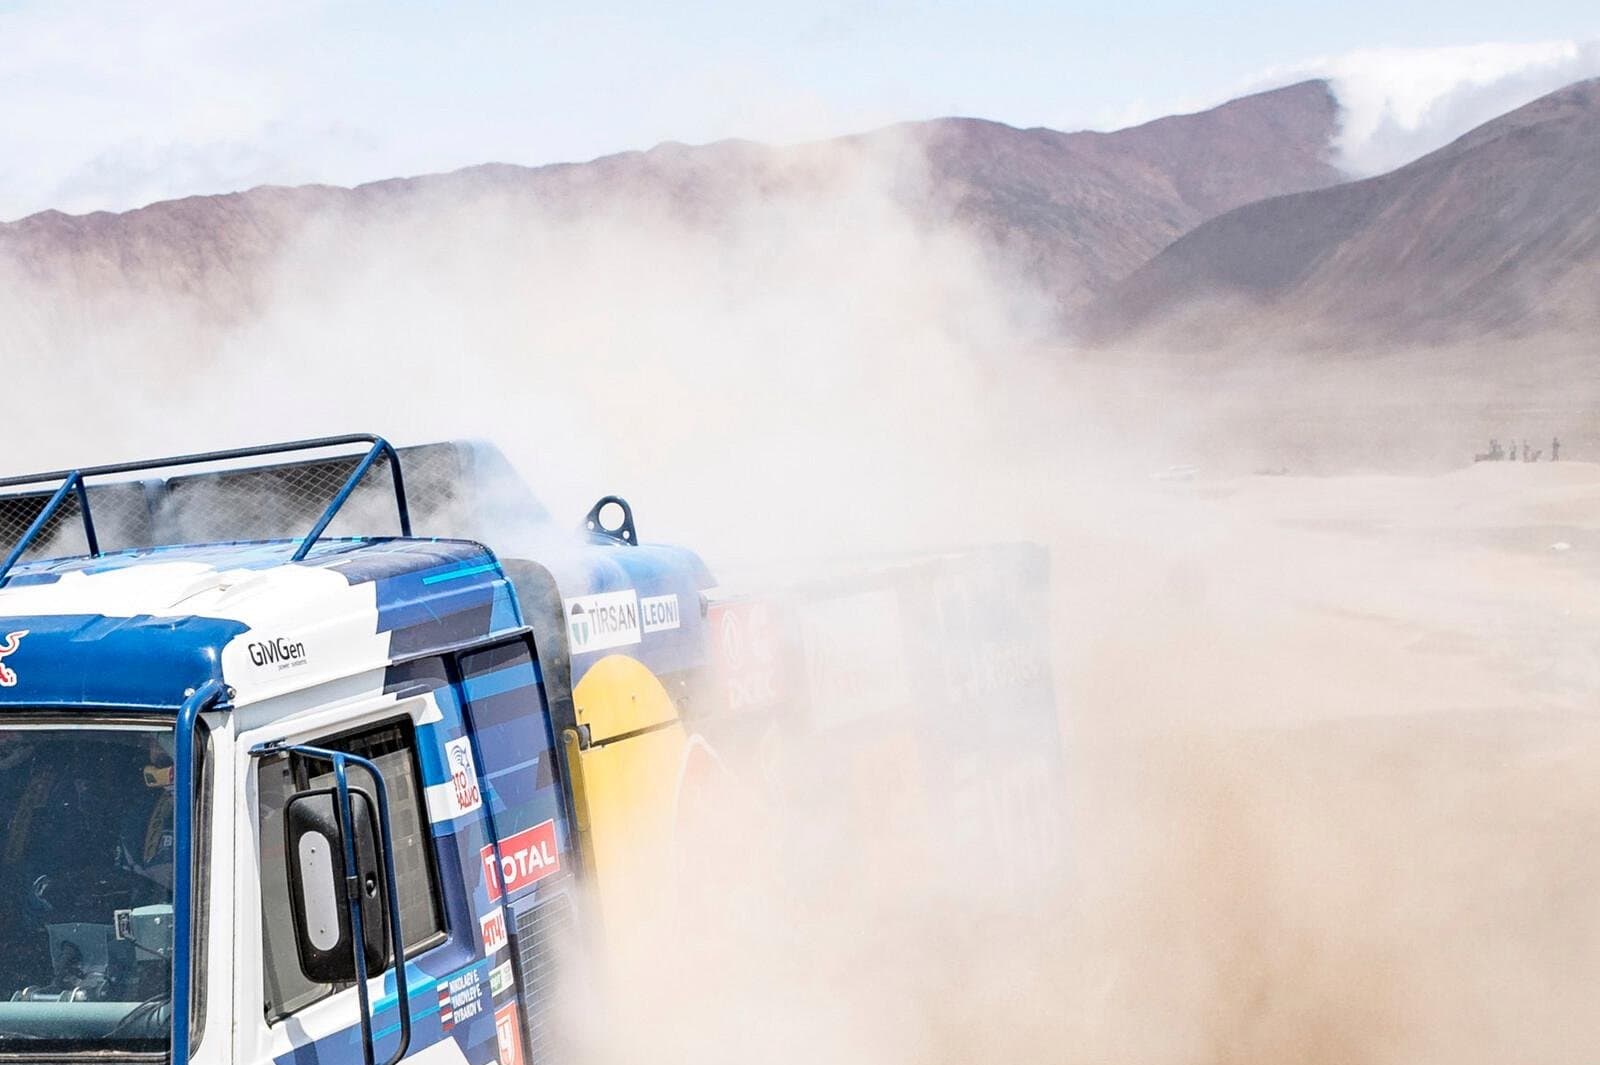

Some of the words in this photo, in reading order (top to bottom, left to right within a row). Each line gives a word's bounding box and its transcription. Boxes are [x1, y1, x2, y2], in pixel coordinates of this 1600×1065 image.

[643, 601, 678, 626] LEONI
[248, 637, 306, 667] GMGen
[485, 840, 556, 889] TOTAL
